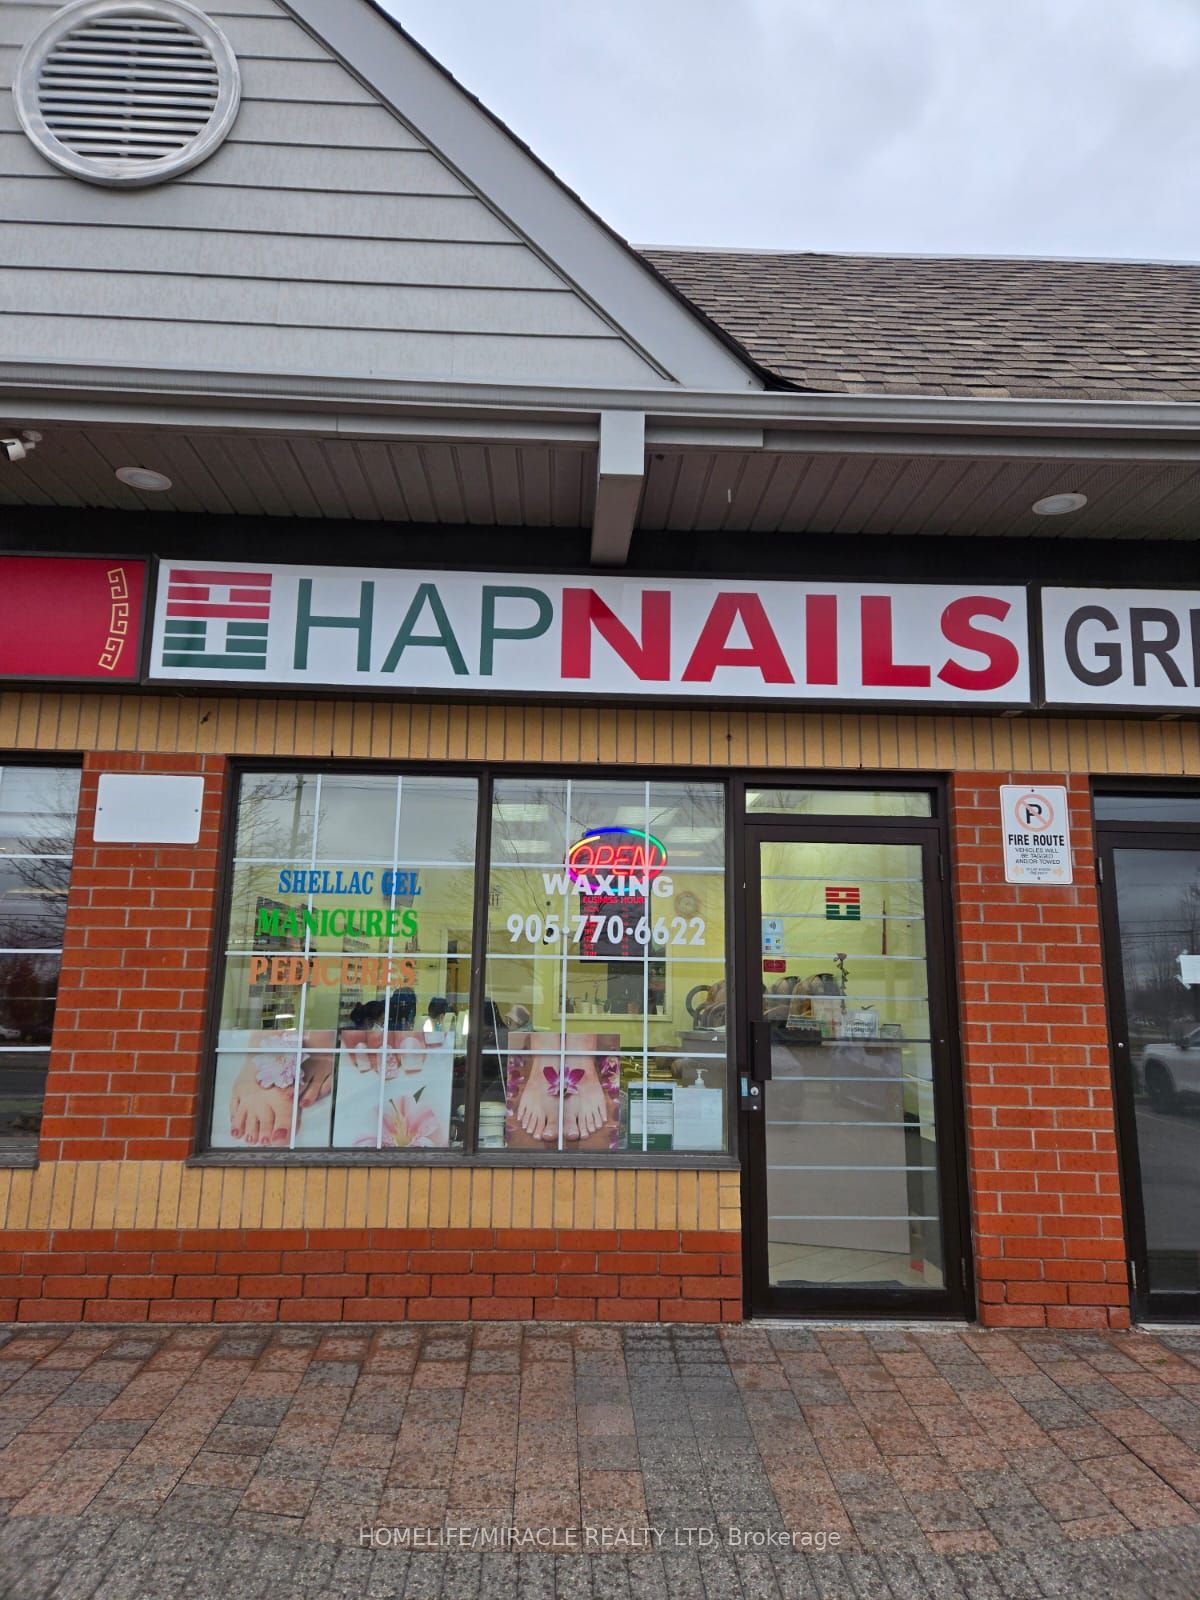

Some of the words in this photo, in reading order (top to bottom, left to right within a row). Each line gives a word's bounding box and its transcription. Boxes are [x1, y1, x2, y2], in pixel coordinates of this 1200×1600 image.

[1008, 834, 1030, 846] FIRE
[1033, 834, 1065, 847] ROUTE
[571, 846, 657, 875] OPEN
[278, 869, 374, 894] SHELLAC
[381, 871, 421, 896] GEL
[542, 873, 674, 897] WAXING
[255, 907, 418, 938] MANICURES
[249, 956, 416, 987] PEDICURES
